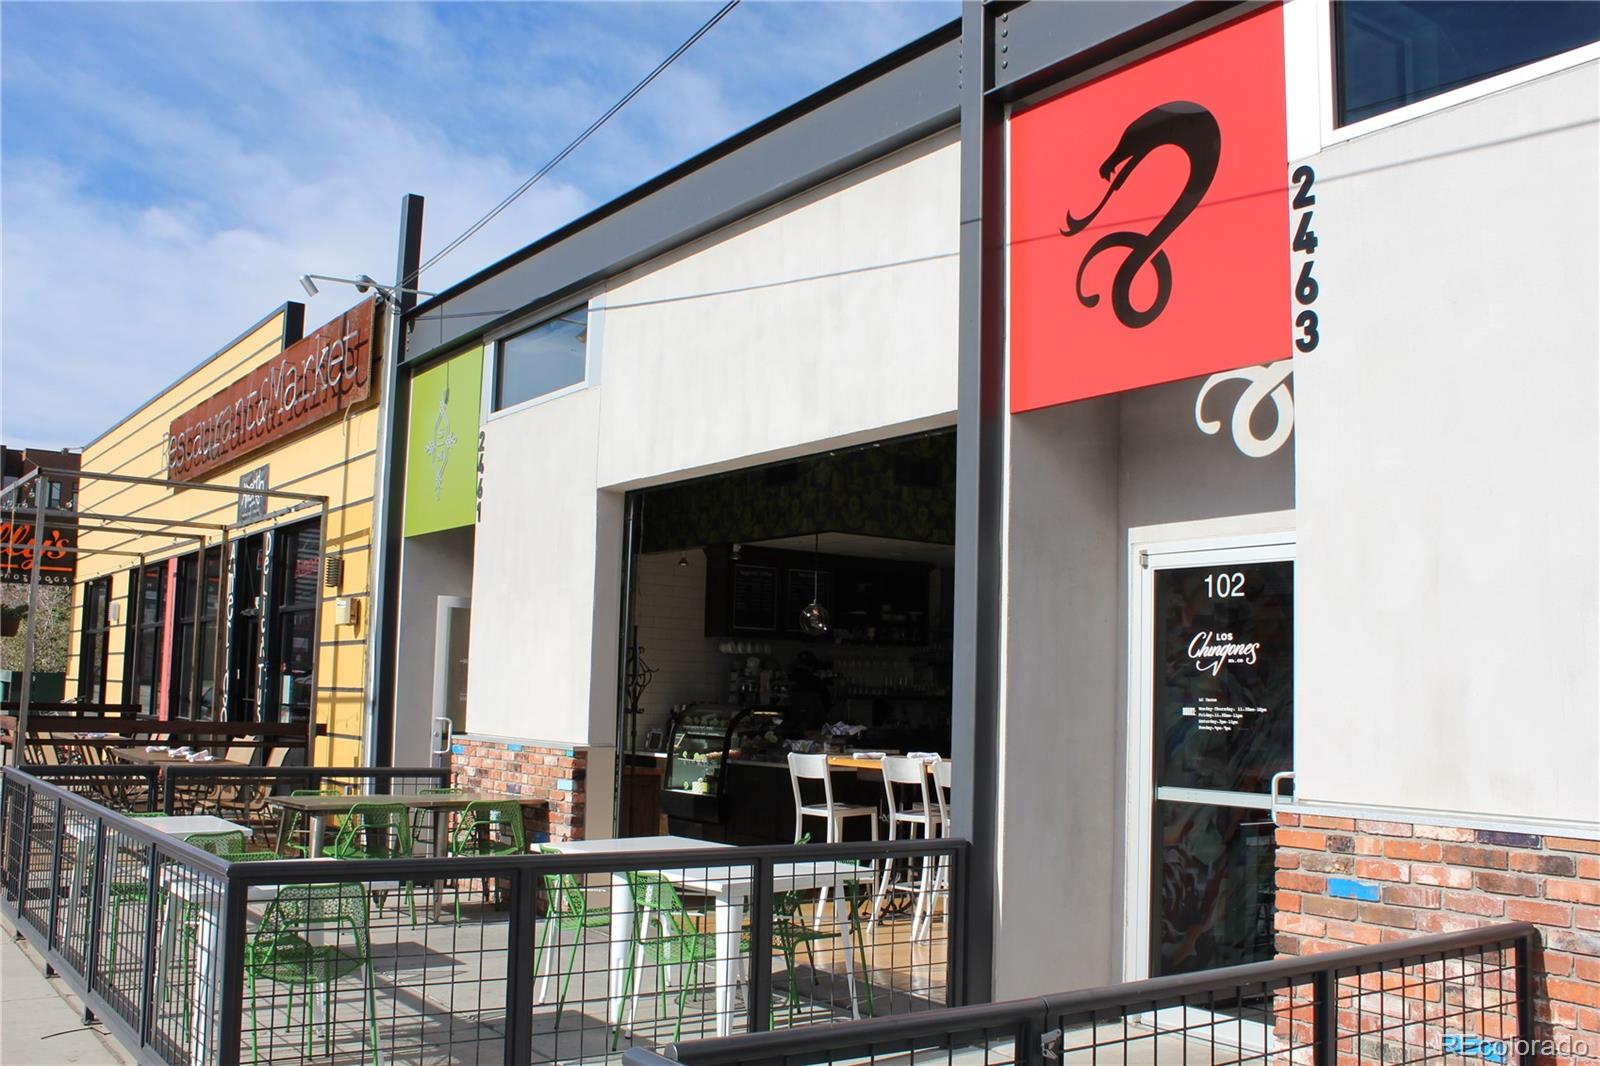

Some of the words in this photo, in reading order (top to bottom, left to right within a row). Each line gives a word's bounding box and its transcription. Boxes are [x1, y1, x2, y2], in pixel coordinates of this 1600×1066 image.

[1292, 165, 1319, 353] 2463
[161, 391, 257, 472] Restaurant
[269, 319, 359, 412] Market
[476, 431, 485, 523] 2461
[1204, 573, 1245, 598] 102
[1188, 631, 1260, 676] Chingones
[1216, 633, 1233, 641] LOS
